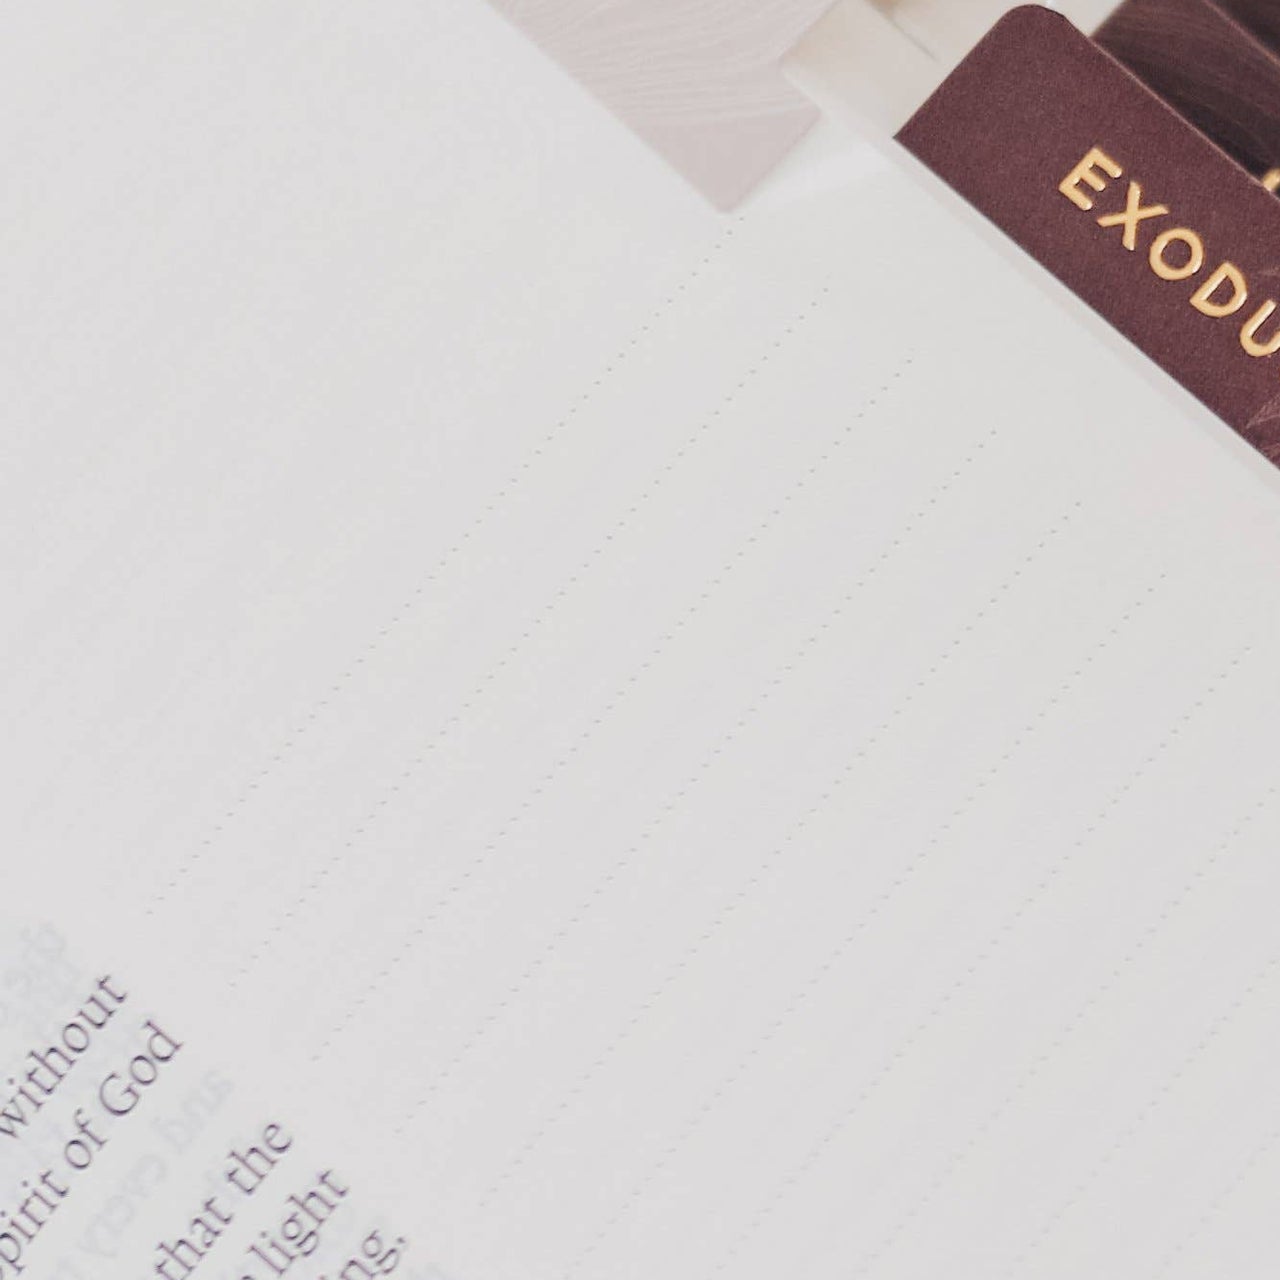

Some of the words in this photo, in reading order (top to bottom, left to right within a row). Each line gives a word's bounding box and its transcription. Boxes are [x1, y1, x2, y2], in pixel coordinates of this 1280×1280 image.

[63, 1107, 107, 1170] of
[98, 1019, 182, 1117] God
[225, 1122, 292, 1195] the
[246, 1169, 348, 1276] light
